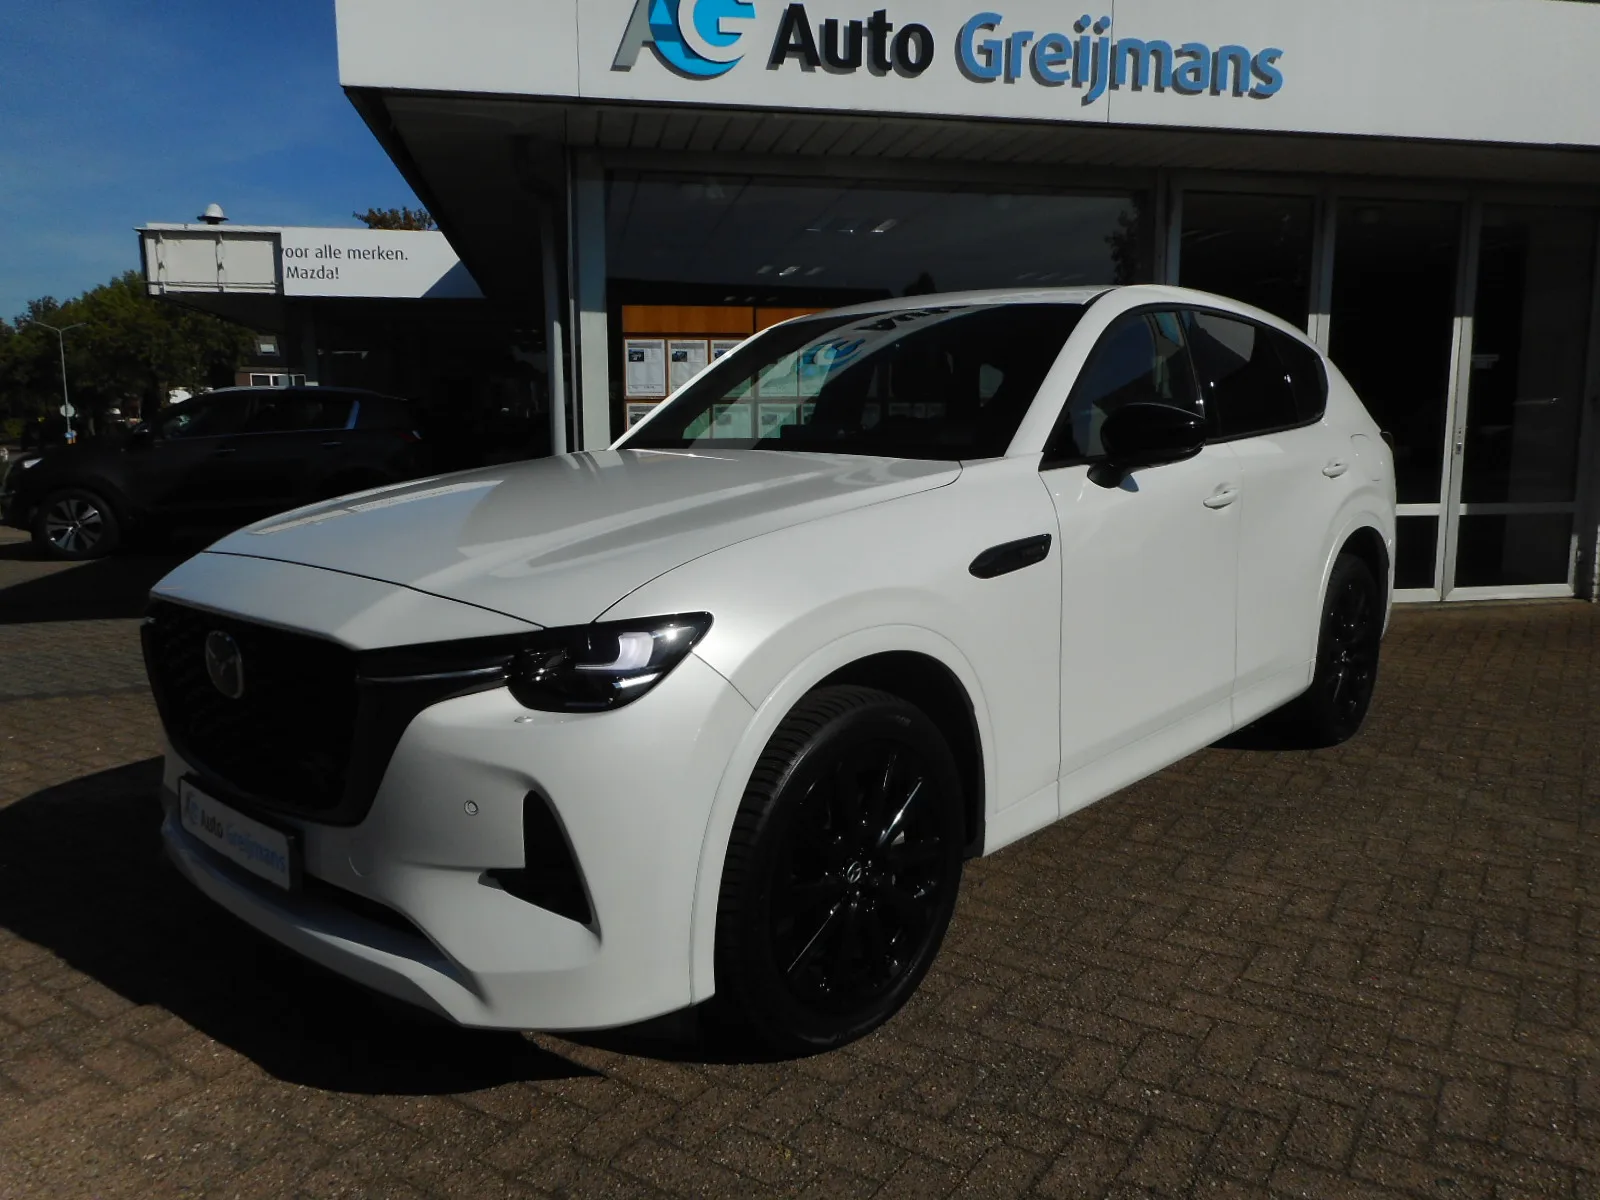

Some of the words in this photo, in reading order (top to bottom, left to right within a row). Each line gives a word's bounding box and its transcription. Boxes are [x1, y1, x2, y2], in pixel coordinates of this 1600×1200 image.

[771, 4, 934, 74] Auto
[960, 12, 1283, 103] Greijmans
[315, 244, 341, 259] alle
[347, 245, 408, 261] merken.
[286, 265, 339, 279] Mazda!
[201, 809, 223, 839] Auto
